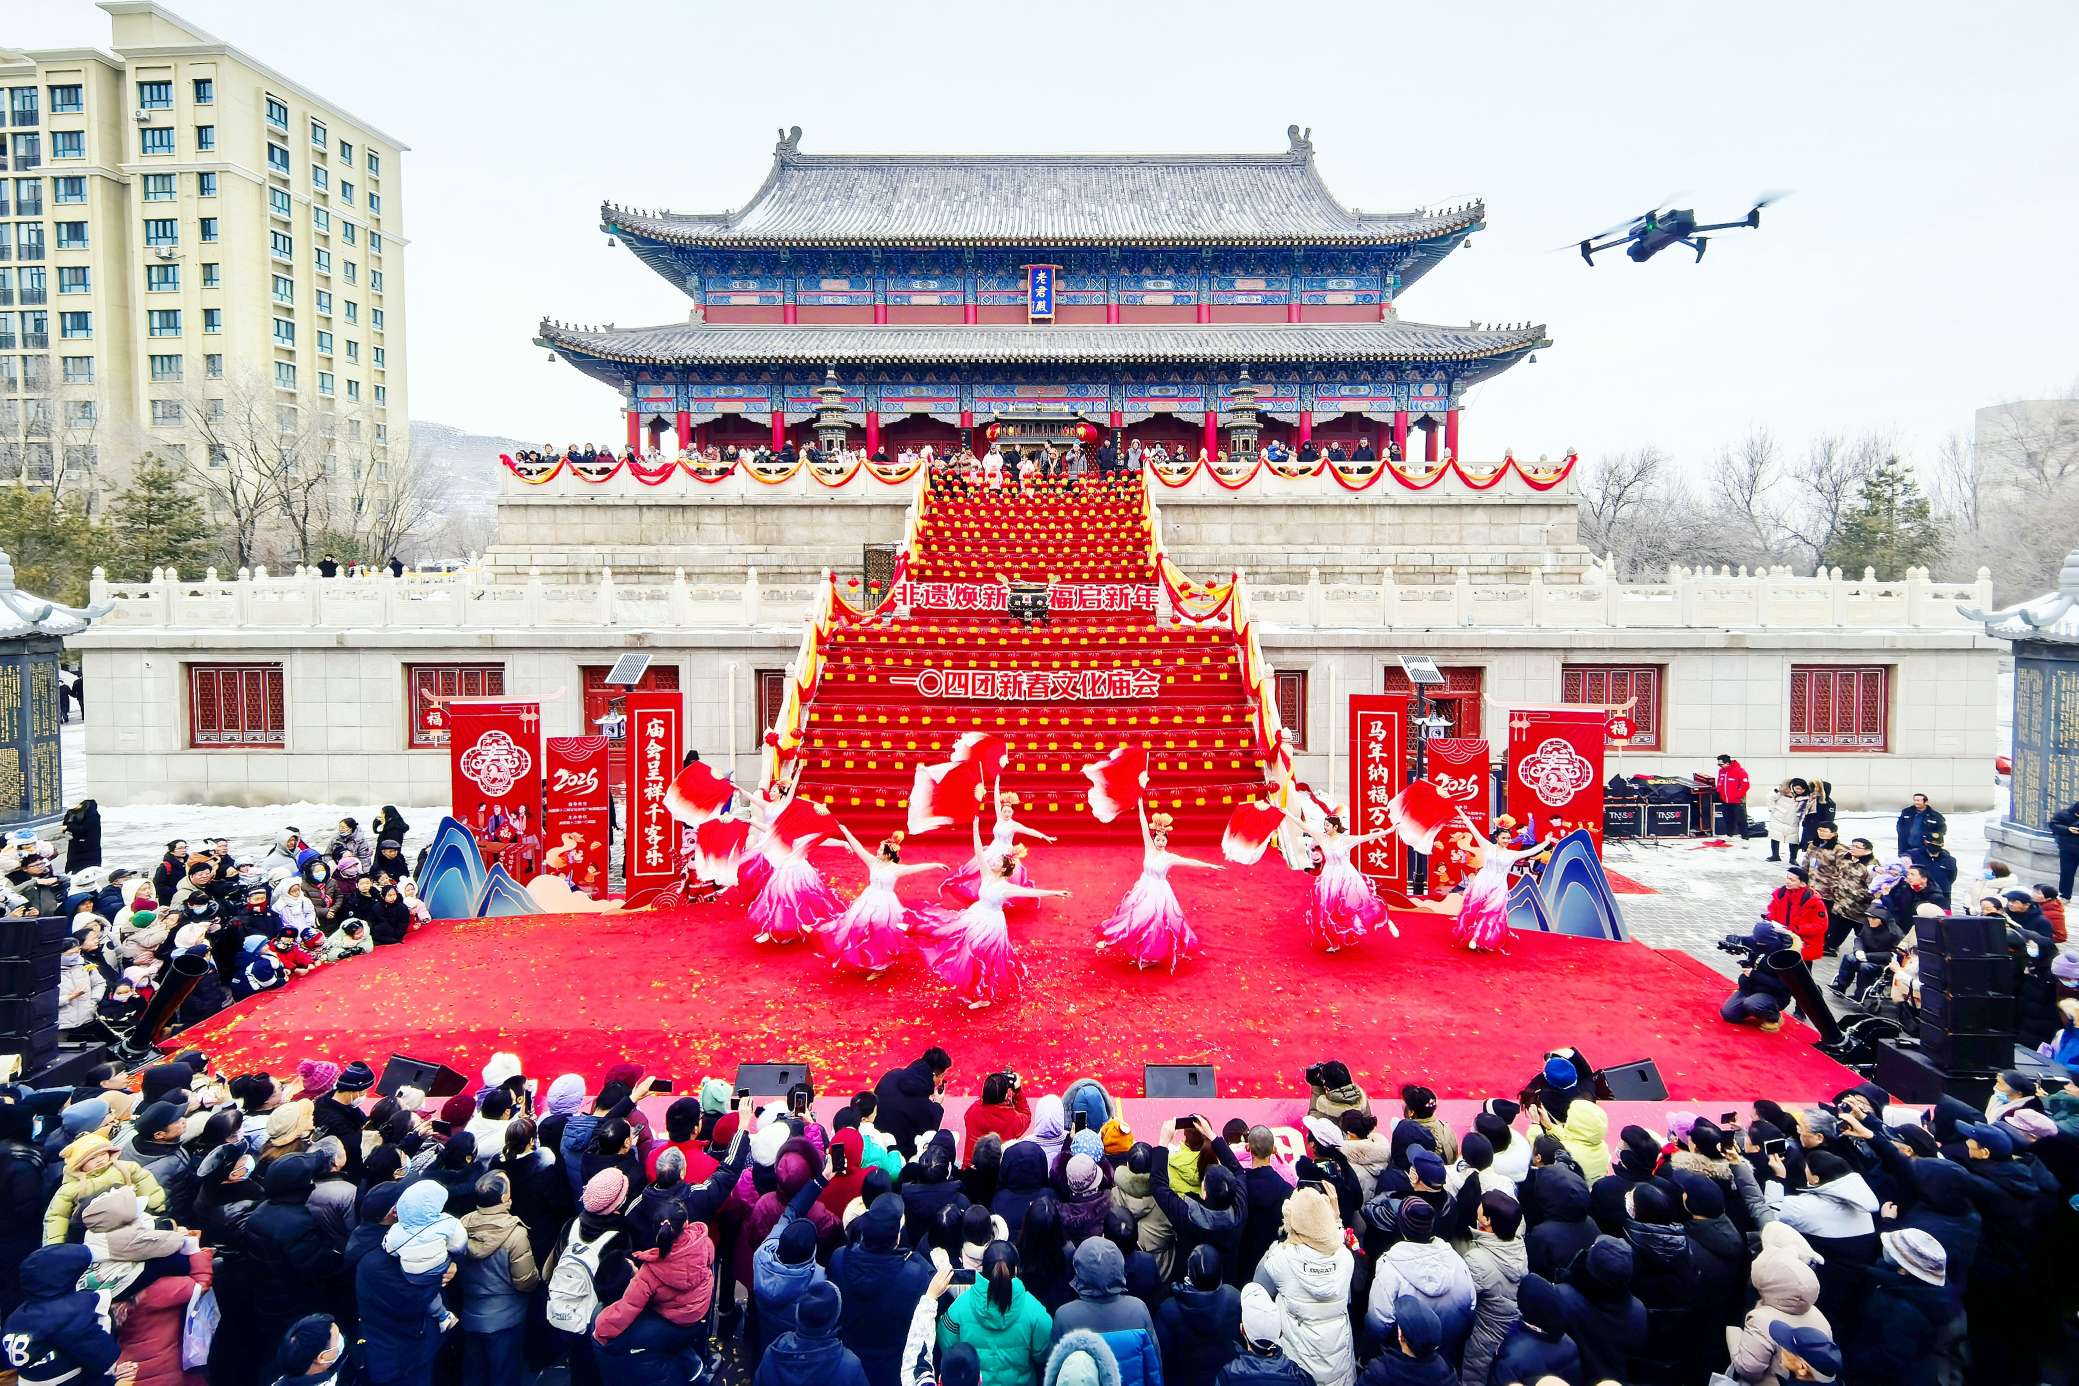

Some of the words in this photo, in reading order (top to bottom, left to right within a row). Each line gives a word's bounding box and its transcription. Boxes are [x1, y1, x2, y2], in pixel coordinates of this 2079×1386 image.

[1035, 269, 1048, 313] 老君殿
[894, 582, 1008, 610] 非遗焕新
[1047, 583, 1160, 610] 福启新年
[889, 669, 1160, 701] 一〇四团新春文化庙会
[426, 711, 443, 727] 福
[1609, 720, 1628, 737] 福
[552, 767, 599, 796] 2026
[643, 717, 666, 867] 庙会呈祥千客乐
[1434, 772, 1479, 801] 2026
